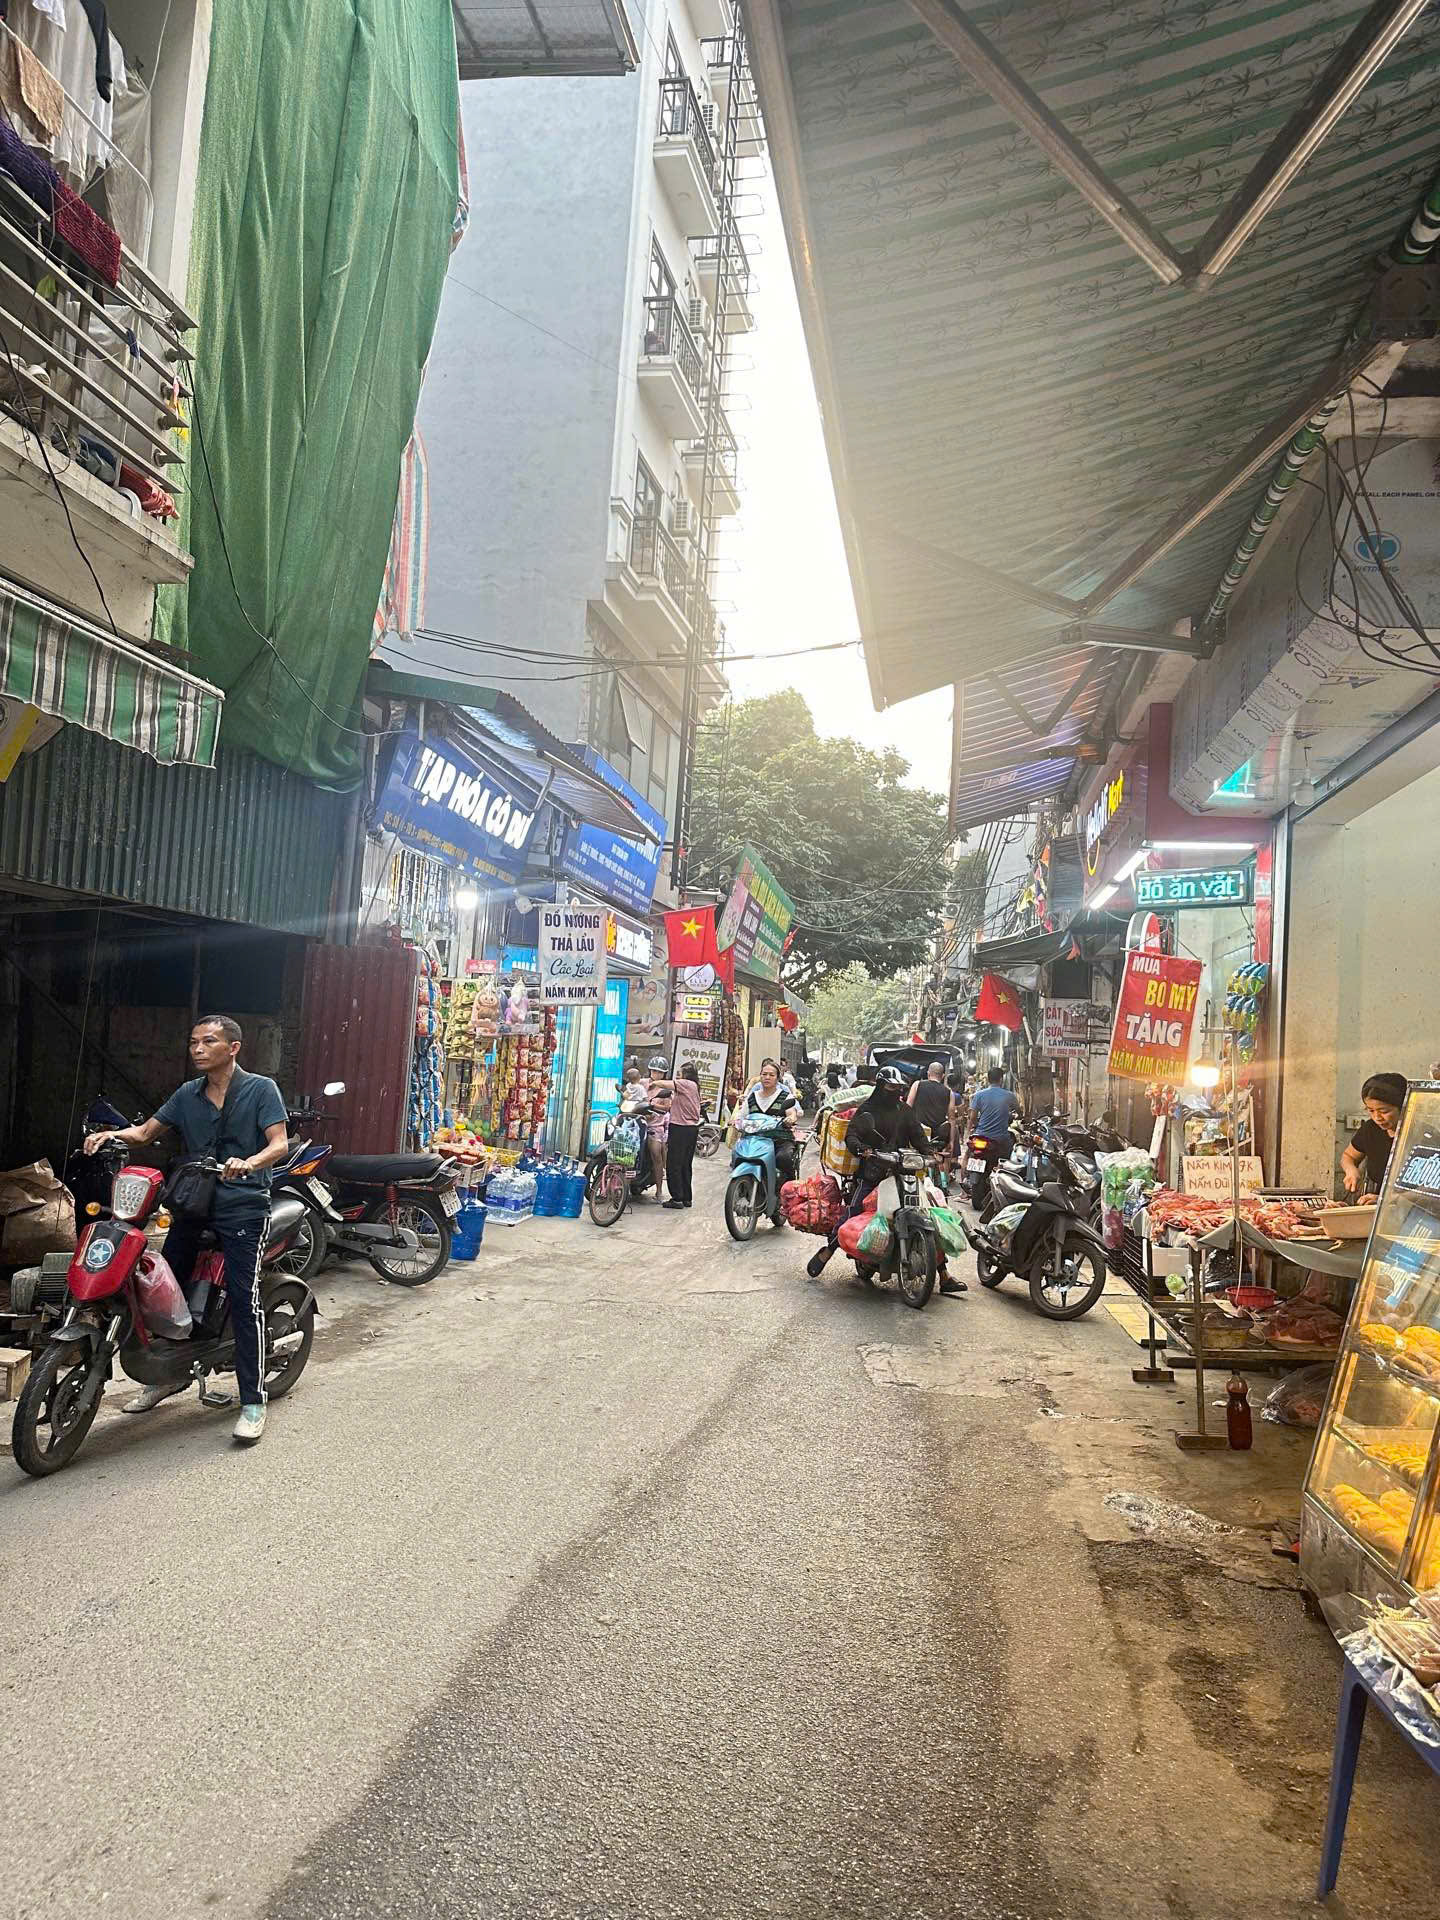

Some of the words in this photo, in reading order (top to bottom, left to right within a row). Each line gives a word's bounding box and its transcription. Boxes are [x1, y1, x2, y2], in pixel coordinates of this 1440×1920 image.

[414, 747, 457, 807] TẠP
[447, 772, 491, 827] HÓA
[485, 794, 513, 837] CÔ
[504, 809, 535, 850] DƯ
[1170, 878, 1196, 898] ăn
[544, 909, 561, 928] ĐỒ
[550, 933, 573, 951] THẢ
[550, 958, 572, 976] Các
[572, 958, 594, 978] Loại
[1132, 955, 1160, 975] MUA
[545, 983, 566, 998] NẤM
[568, 986, 586, 998] KIM
[588, 986, 598, 998] 7K
[604, 984, 621, 1016] NHÀ
[1144, 975, 1167, 1008] BÒ
[1168, 980, 1198, 1012] MỸ
[1126, 1012, 1183, 1048] TẶNG
[1135, 1055, 1154, 1075] KIM
[1186, 1158, 1210, 1171] NẤM
[1213, 1160, 1233, 1172] KIM
[1189, 1176, 1212, 1189] NẤM
